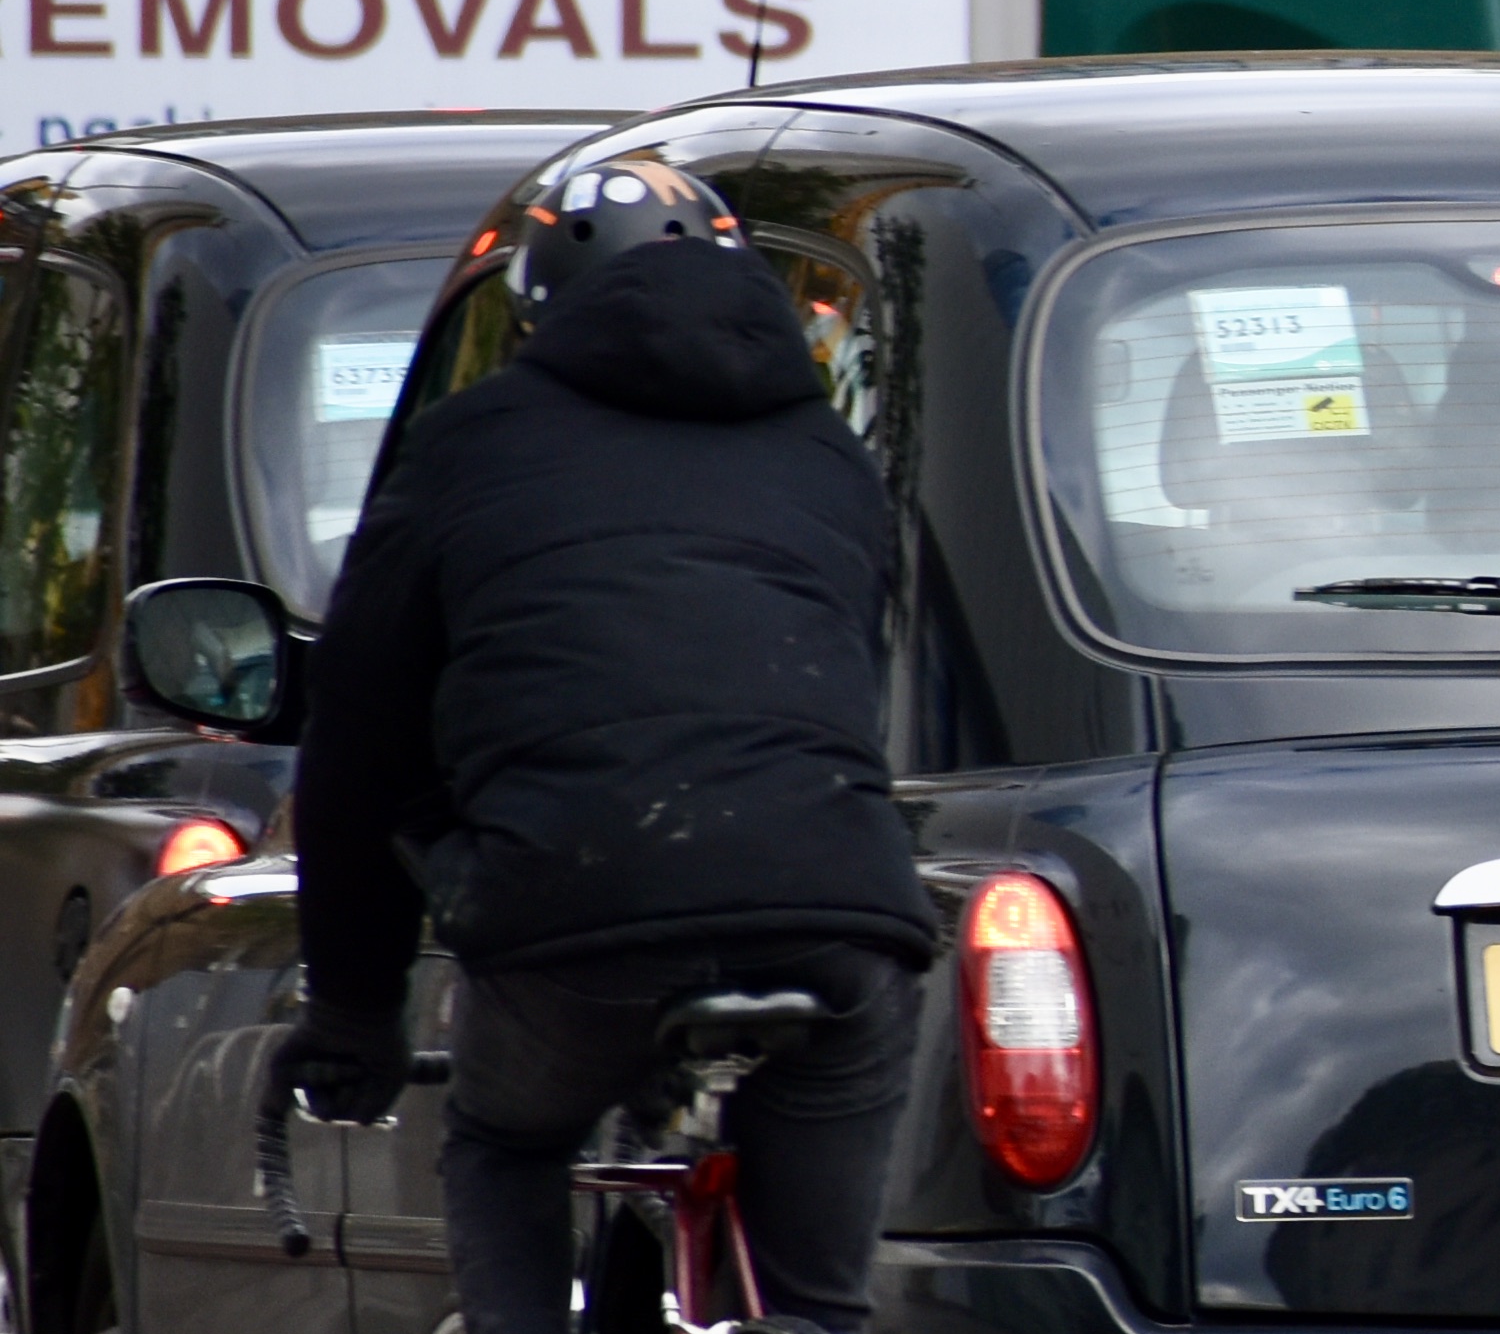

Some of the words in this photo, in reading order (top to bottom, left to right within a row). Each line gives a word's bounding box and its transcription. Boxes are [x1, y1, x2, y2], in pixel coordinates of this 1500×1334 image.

[1216, 315, 1302, 339] 52313
[1242, 1186, 1325, 1214] TX4
[1326, 1187, 1386, 1211] Euro
[1387, 1186, 1408, 1211] 6
